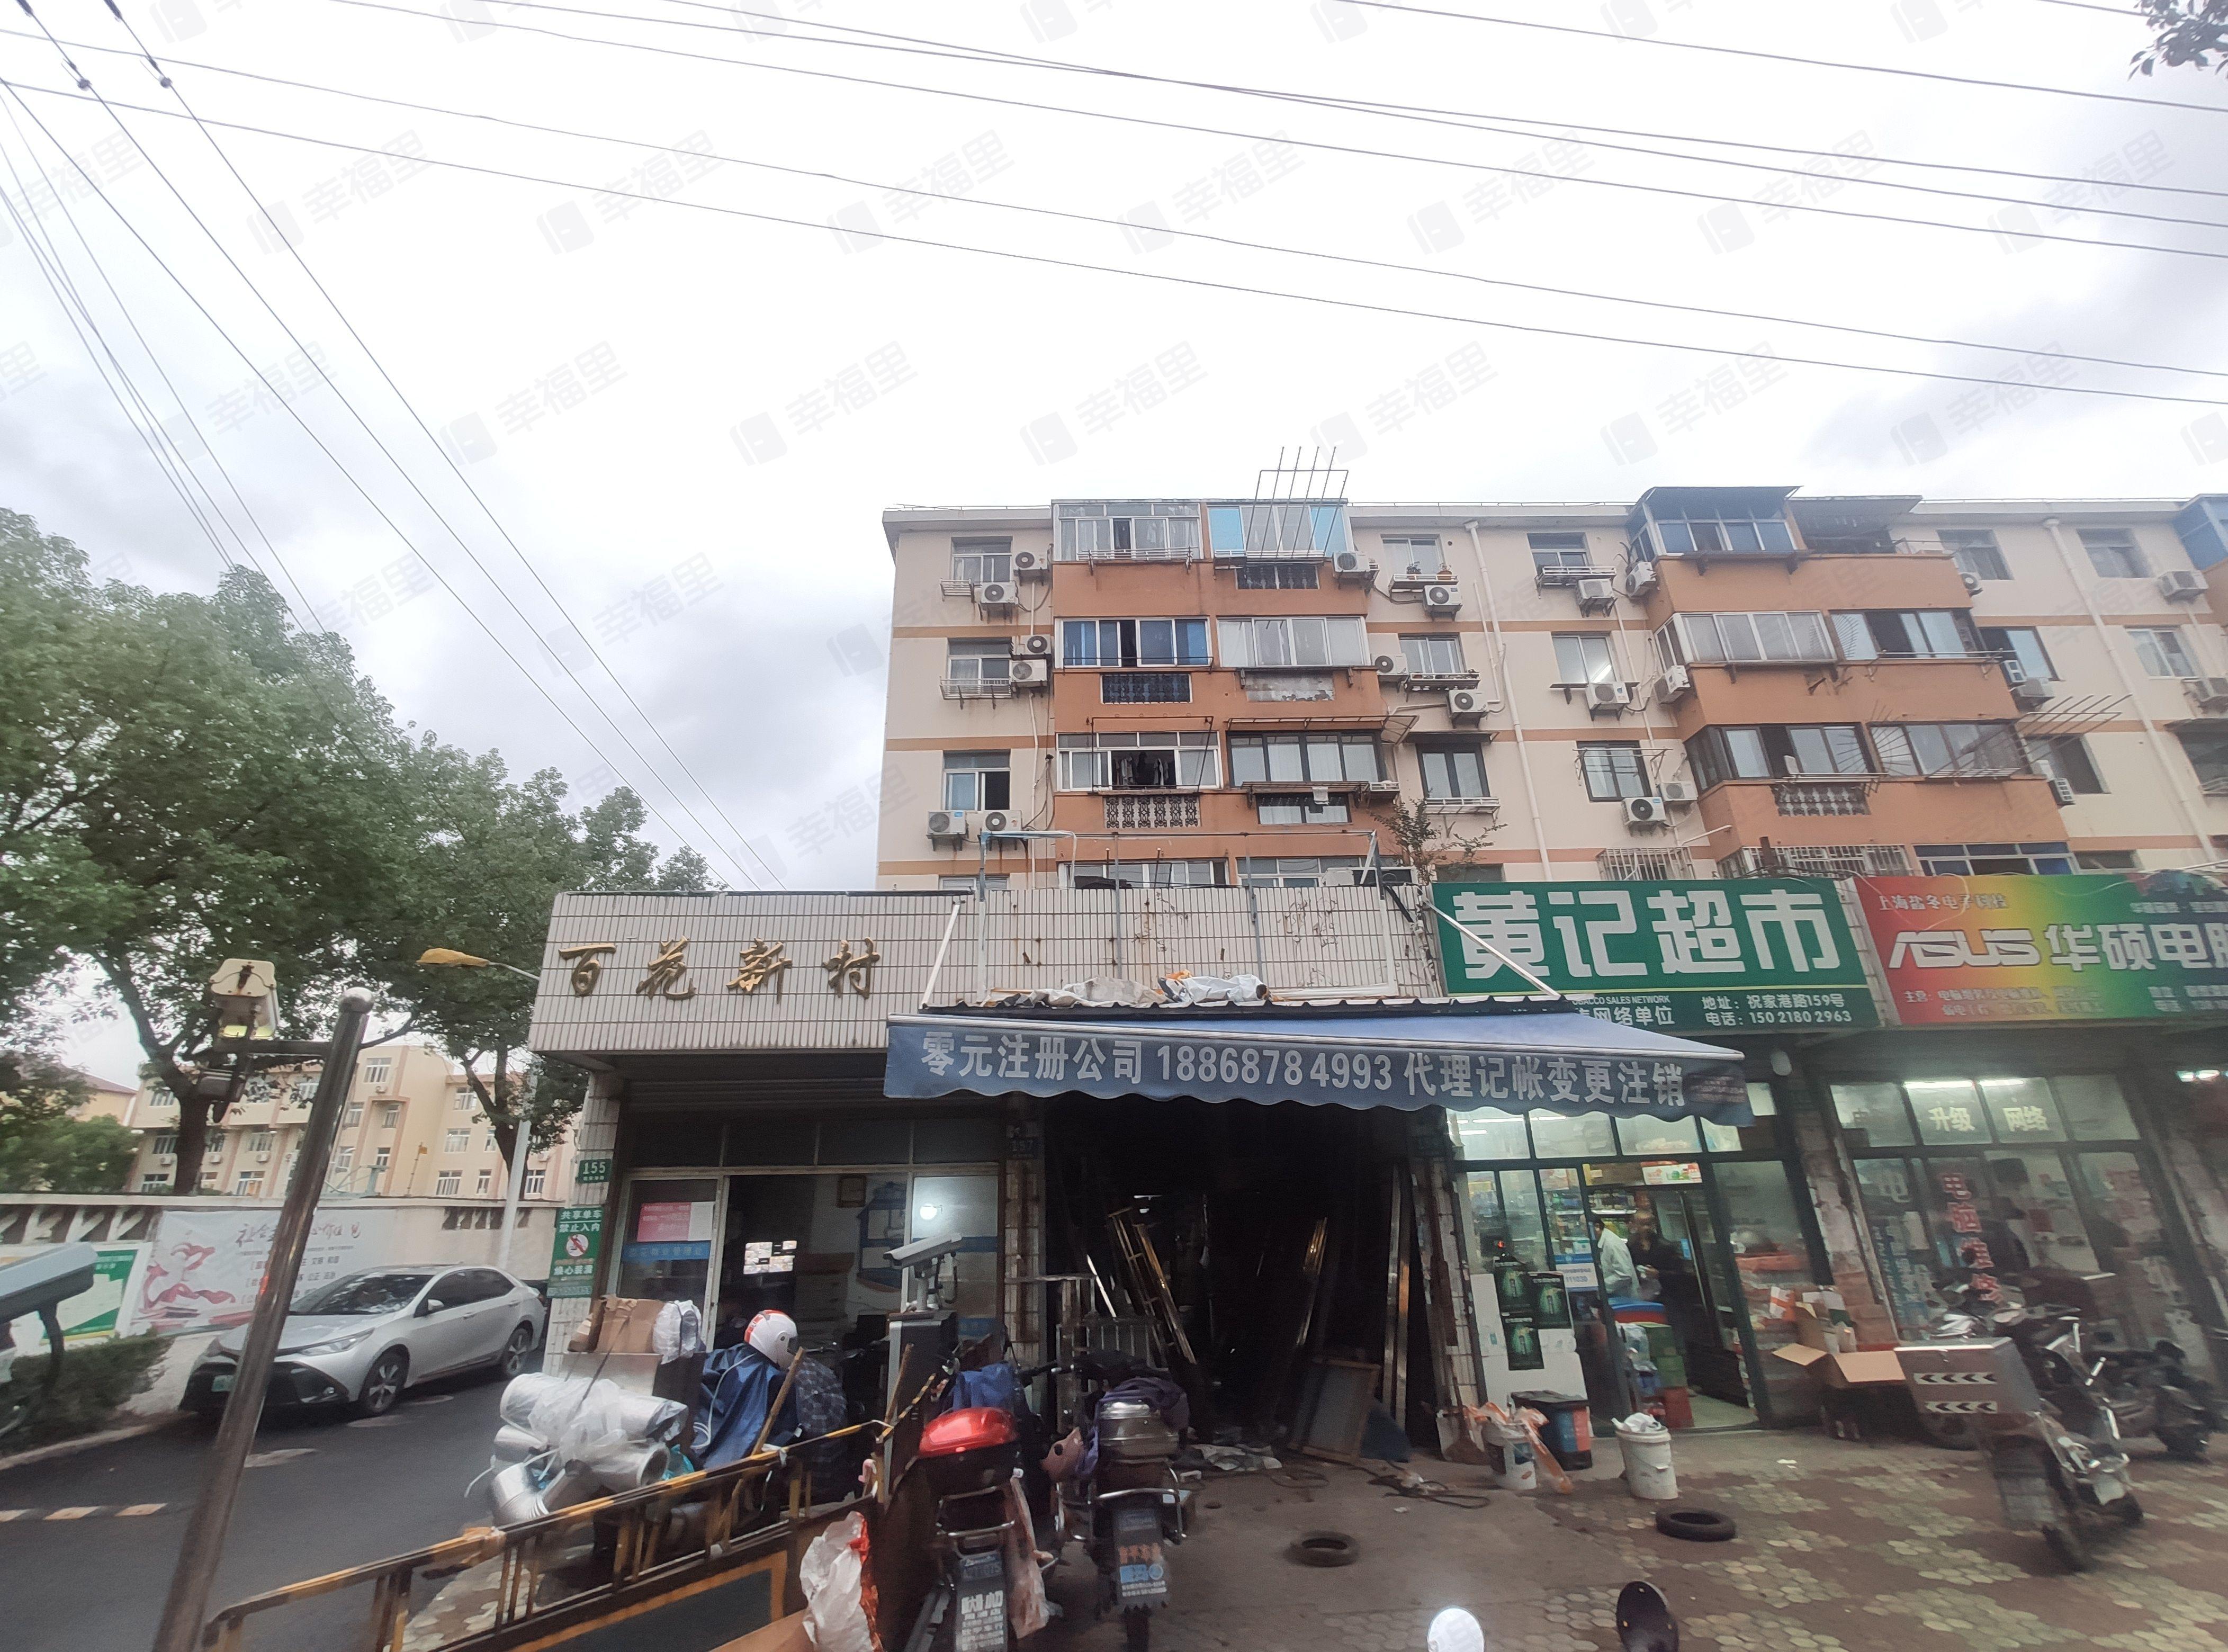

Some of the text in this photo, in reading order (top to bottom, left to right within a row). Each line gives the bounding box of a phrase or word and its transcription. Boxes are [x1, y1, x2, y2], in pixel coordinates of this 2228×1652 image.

[1452, 890, 1841, 980] 黄记超市
[1888, 929, 2041, 968] ASUS
[558, 935, 880, 1004] 百花新村
[1606, 996, 1631, 1004] SALES
[1632, 995, 1671, 1004] NETWORK
[922, 1031, 1143, 1084] 零元注册公司
[1156, 1045, 1392, 1090] 18868784993
[1404, 1051, 1686, 1107] 代理记帐变更注销
[582, 1162, 606, 1174] 155
[560, 1209, 603, 1220] 共享单车
[559, 1222, 601, 1233] 禁止入内
